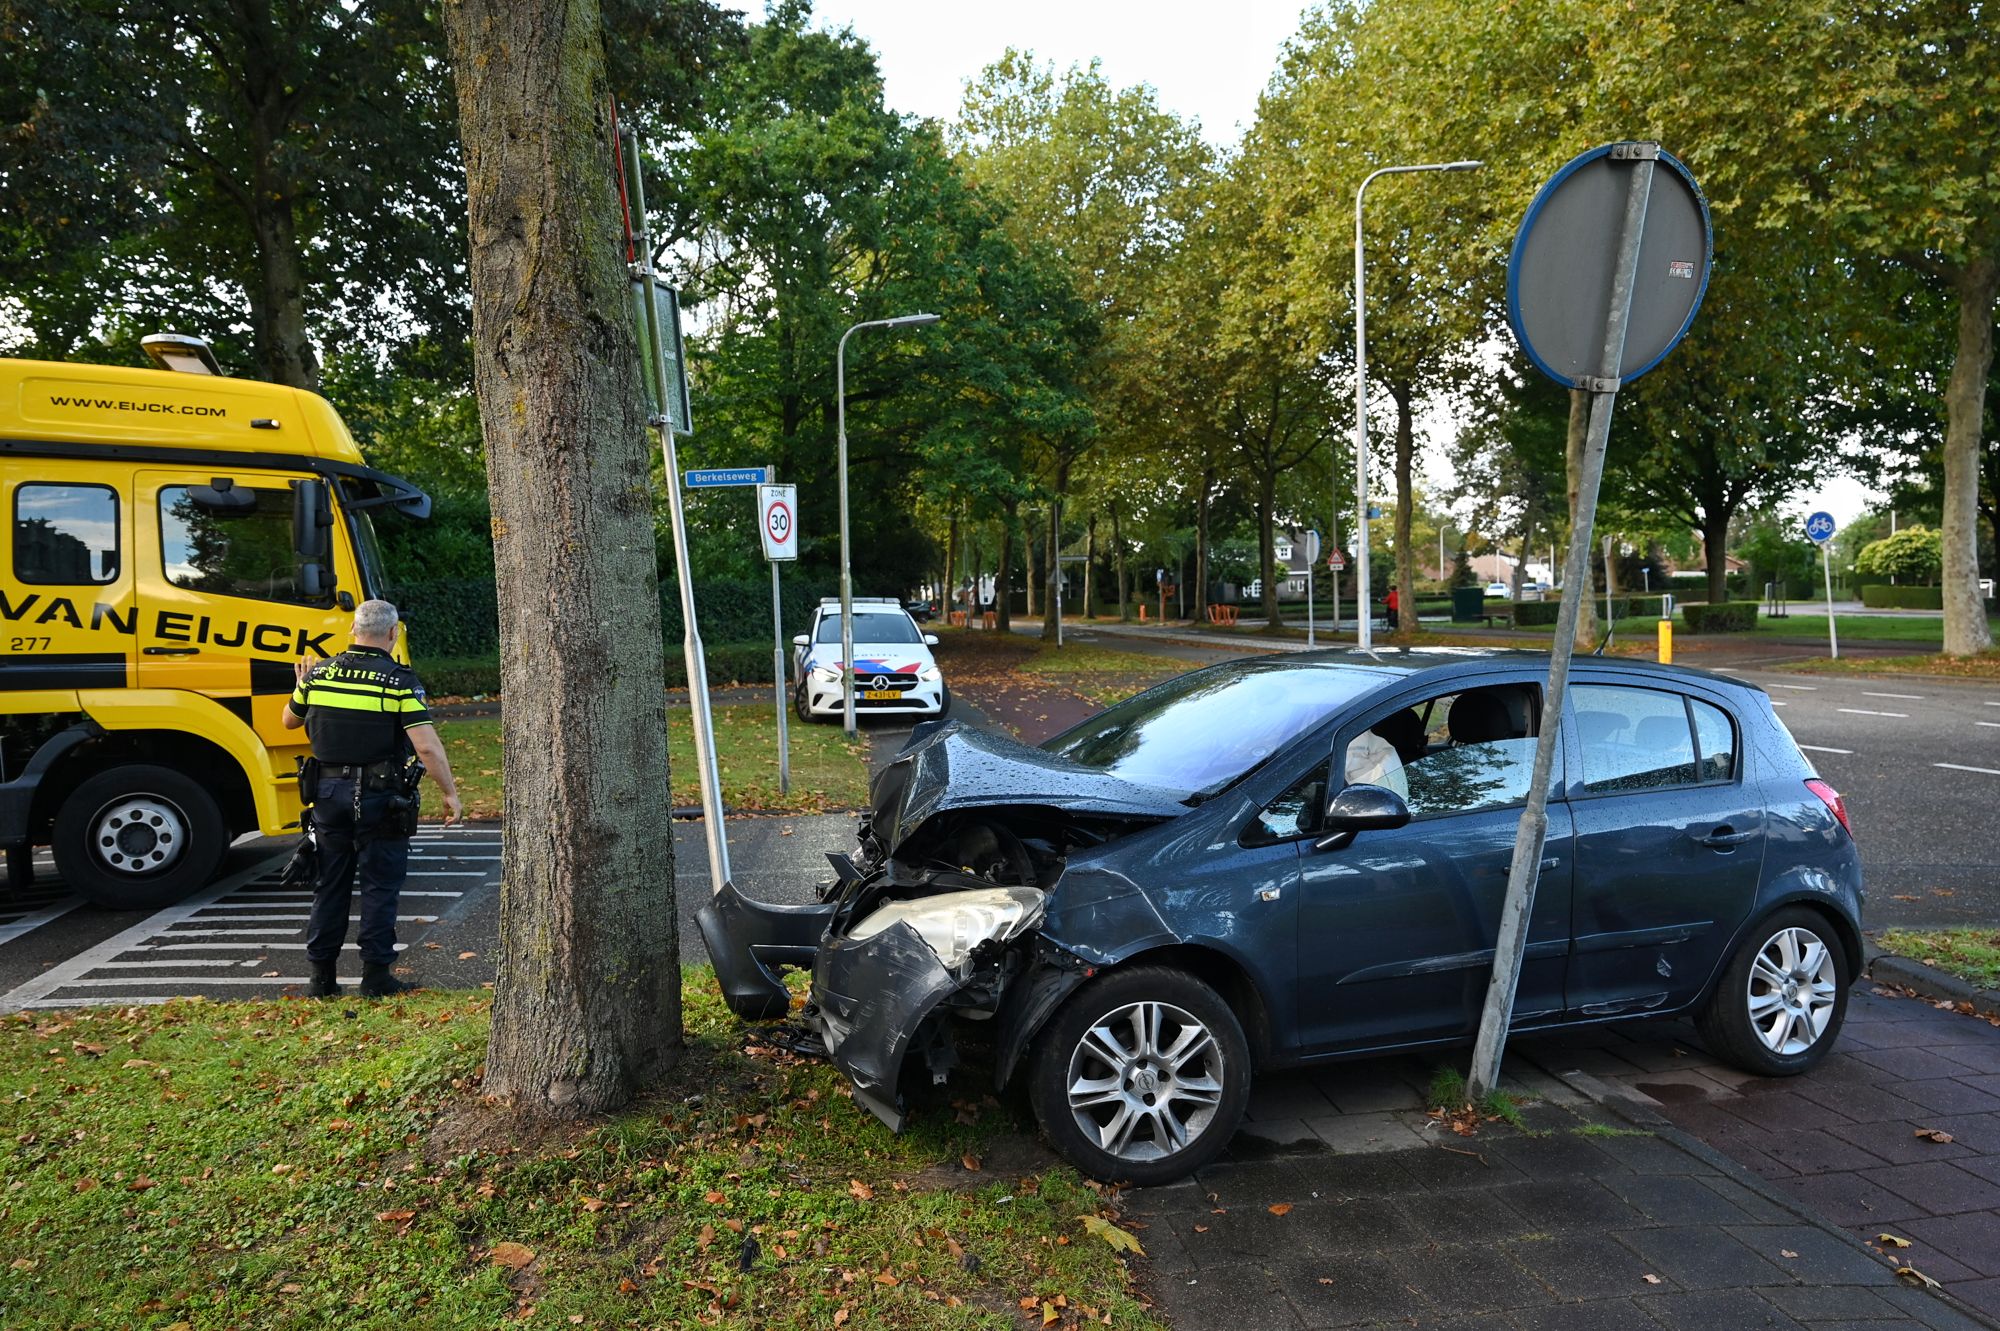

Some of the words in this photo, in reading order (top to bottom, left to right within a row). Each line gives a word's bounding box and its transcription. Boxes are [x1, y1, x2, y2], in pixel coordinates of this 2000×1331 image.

[50, 396, 227, 417] WWW.EIJCK.COM
[695, 472, 757, 482] Berkelseweg
[770, 489, 786, 498] ZONE
[771, 514, 788, 531] 30
[0, 590, 139, 635] VAN
[155, 611, 336, 659] EIJCK
[11, 636, 52, 651] 277
